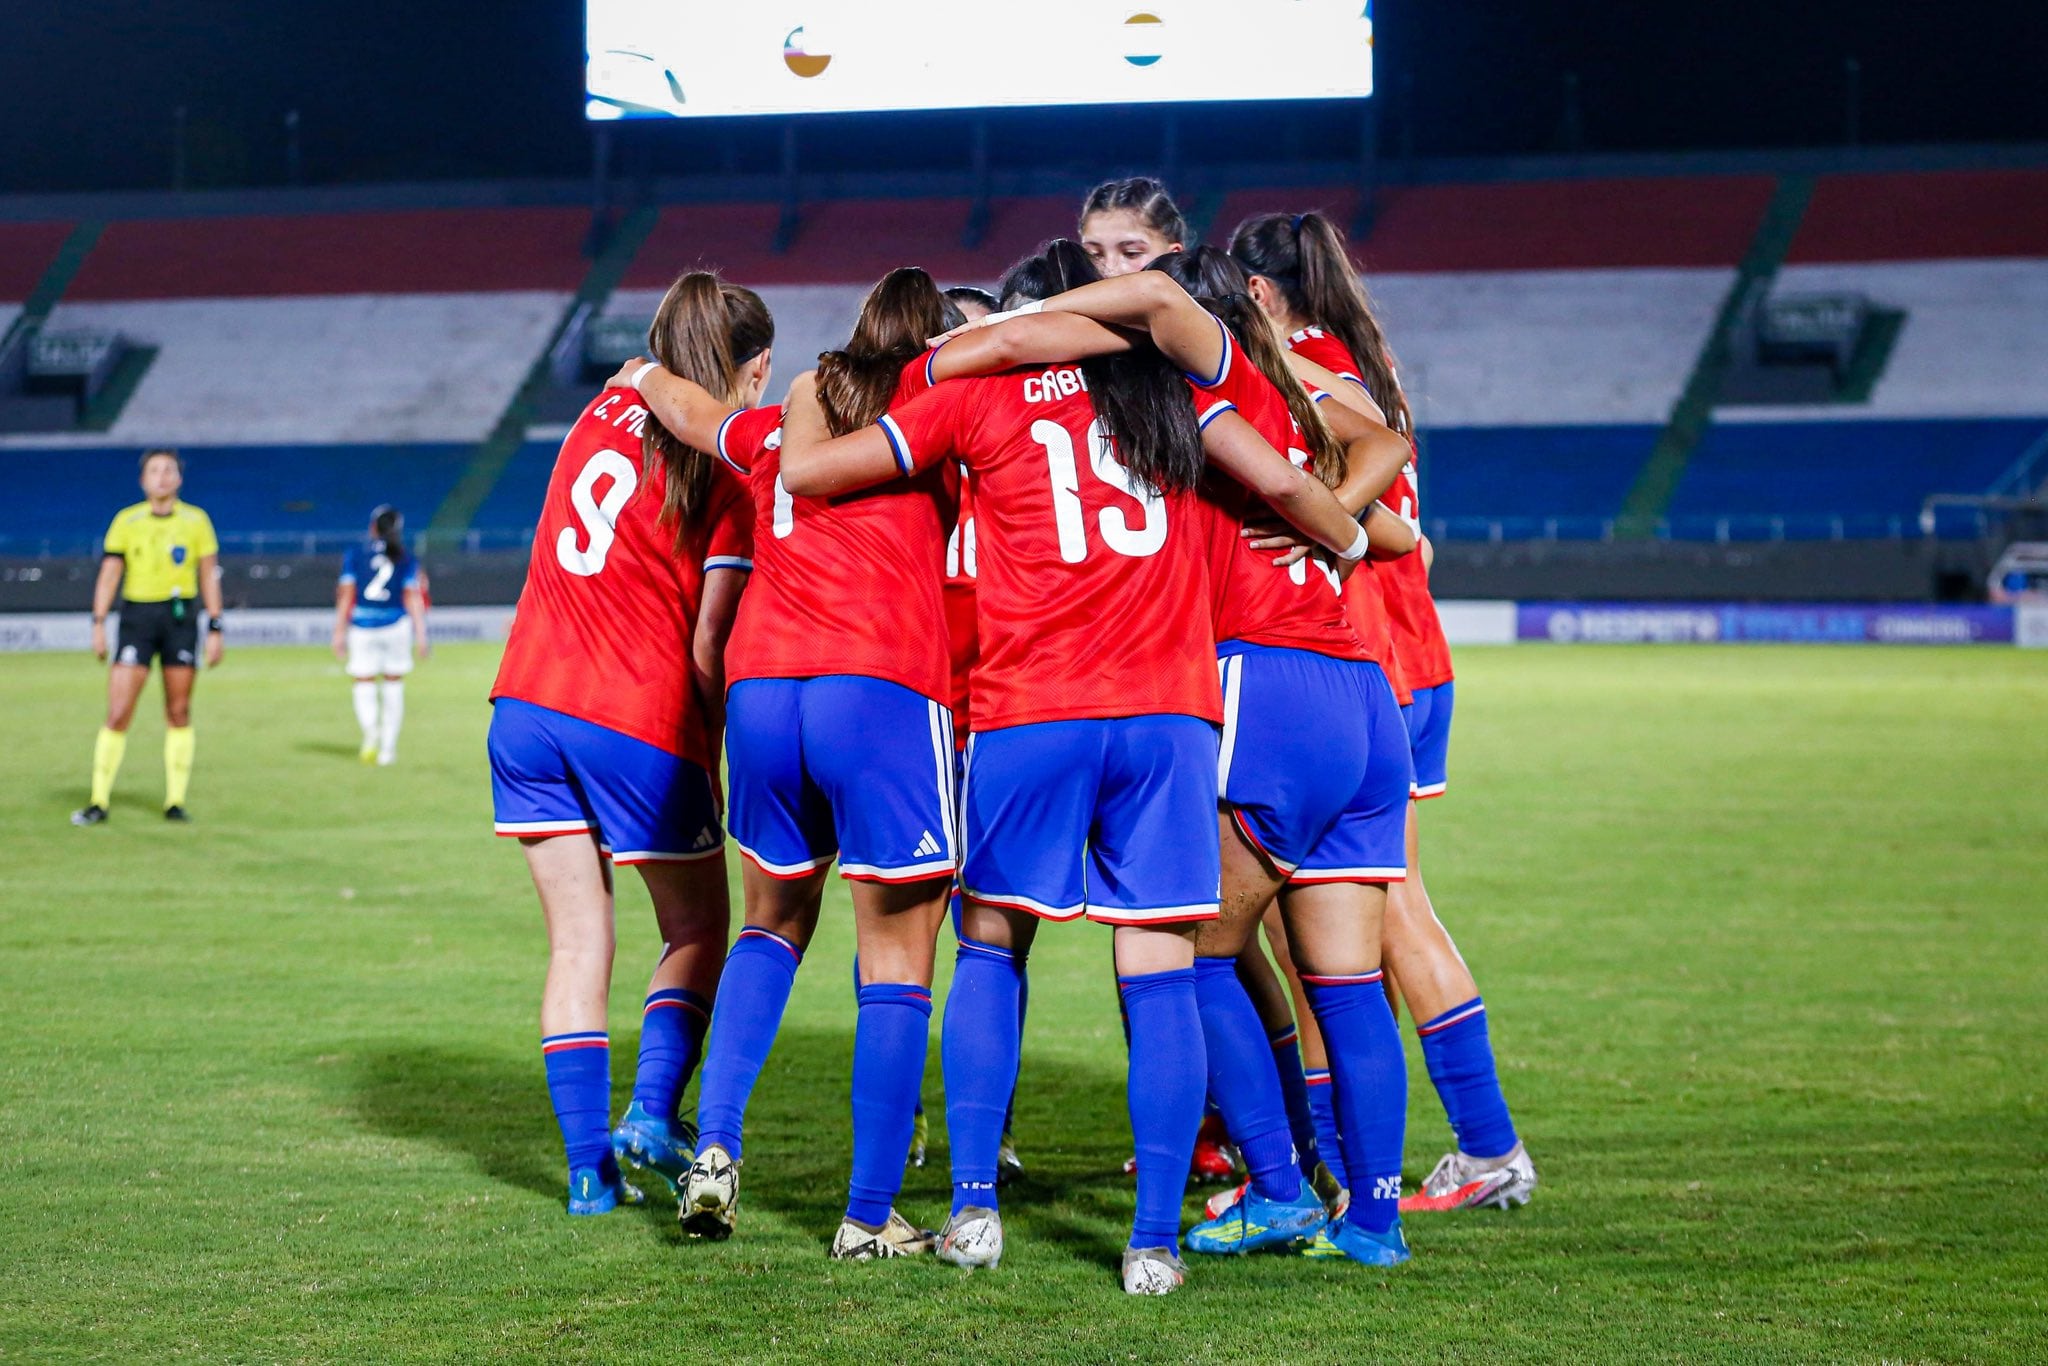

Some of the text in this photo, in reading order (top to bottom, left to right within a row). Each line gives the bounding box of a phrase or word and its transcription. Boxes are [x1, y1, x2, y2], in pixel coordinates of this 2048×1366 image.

[593, 394, 622, 420] C.
[556, 448, 638, 577] 9
[1030, 418, 1168, 564] 15
[363, 553, 395, 602] 2
